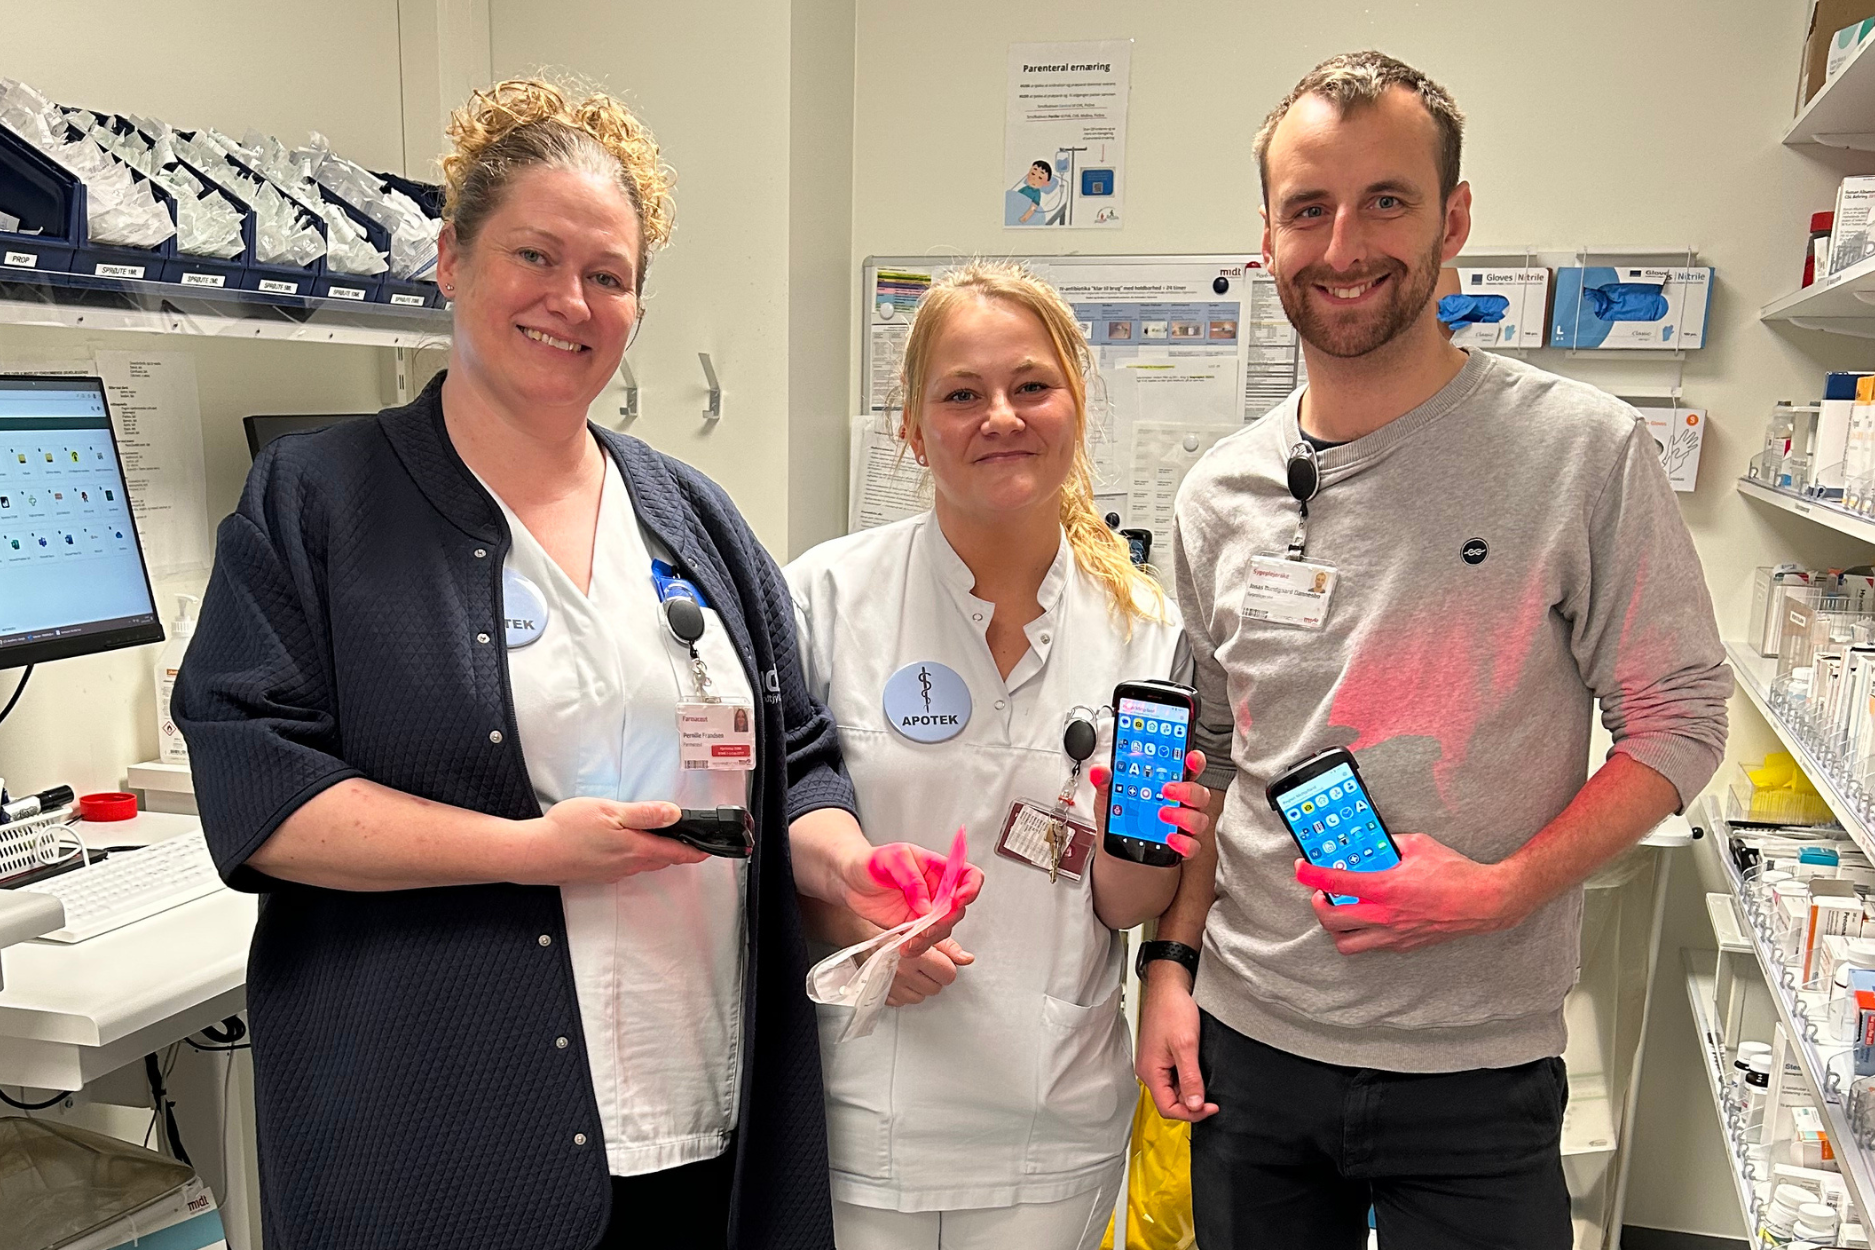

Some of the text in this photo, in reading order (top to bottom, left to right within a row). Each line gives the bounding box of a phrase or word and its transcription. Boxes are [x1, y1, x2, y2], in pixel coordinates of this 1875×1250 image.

[1023, 62, 1111, 73] Parenteral ernæring
[12, 255, 30, 264] PROP
[1220, 267, 1242, 276] midt
[1677, 272, 1706, 280] Nitrile
[1486, 273, 1545, 281] Gloves Nitrile
[1556, 325, 1564, 335] L
[1689, 415, 1696, 424] S
[504, 618, 536, 630] TEK
[902, 714, 959, 726] APOTEK
